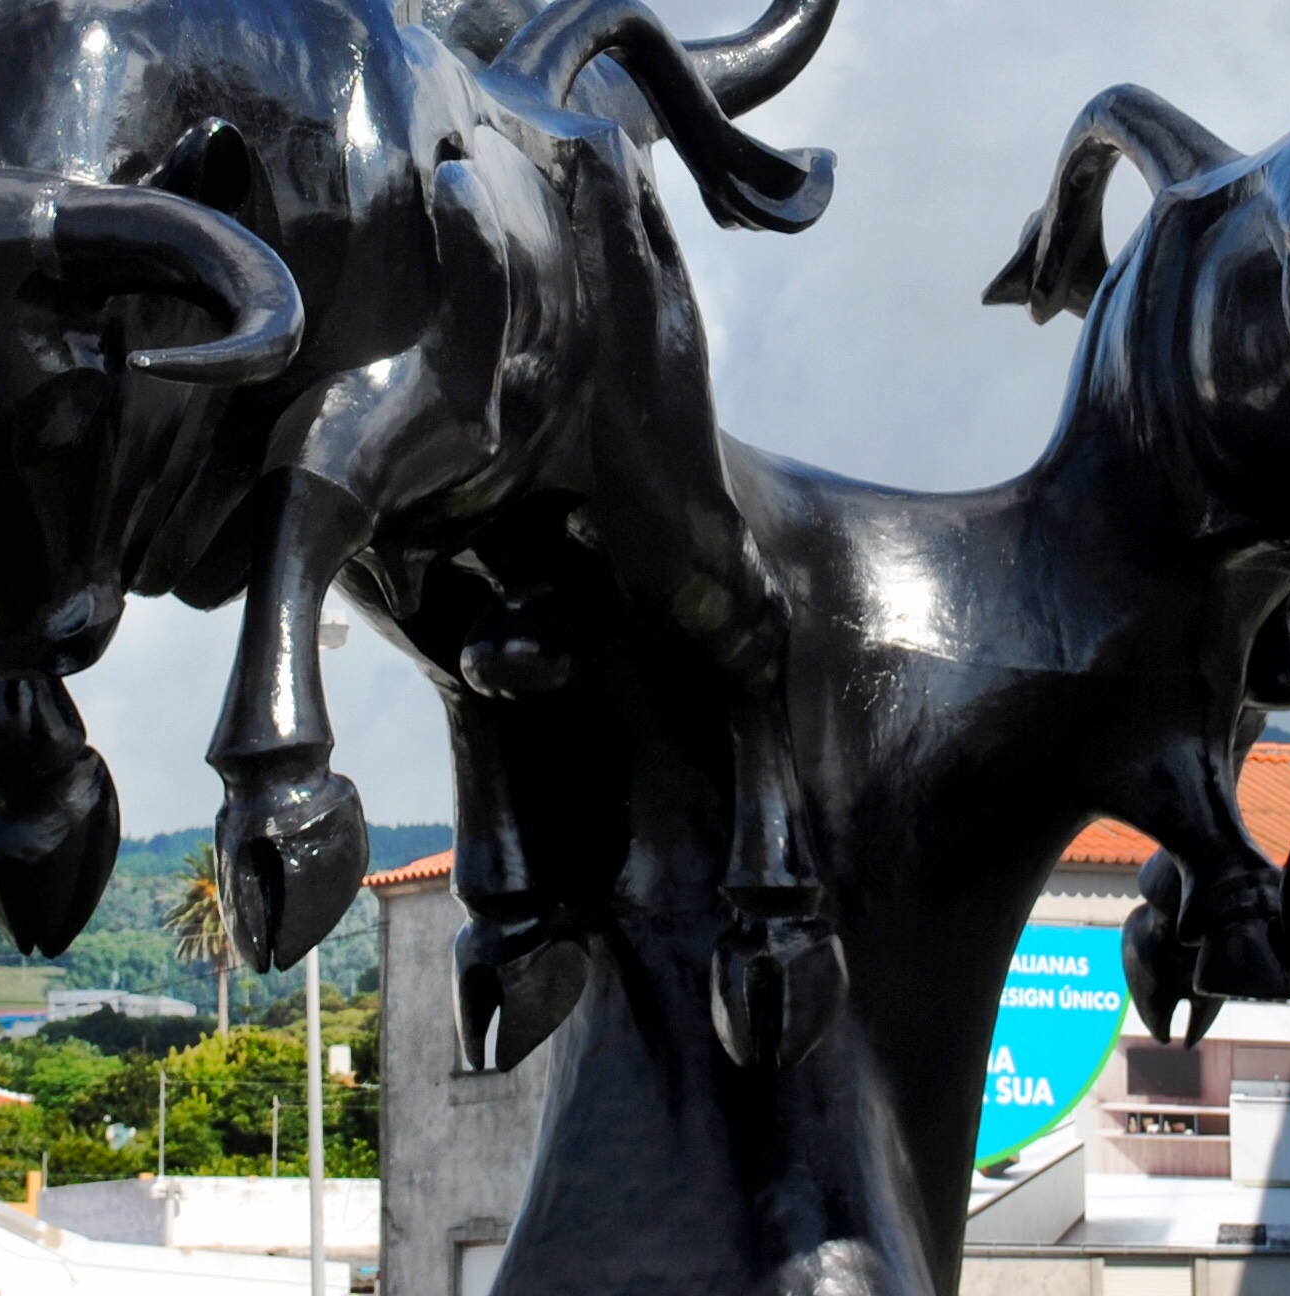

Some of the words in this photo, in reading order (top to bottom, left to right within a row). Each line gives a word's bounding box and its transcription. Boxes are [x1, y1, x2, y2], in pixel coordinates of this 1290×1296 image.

[1008, 954, 1089, 976] ALIANAS
[1059, 985, 1121, 1011] ÚNICO
[996, 1076, 1055, 1106] SUA
